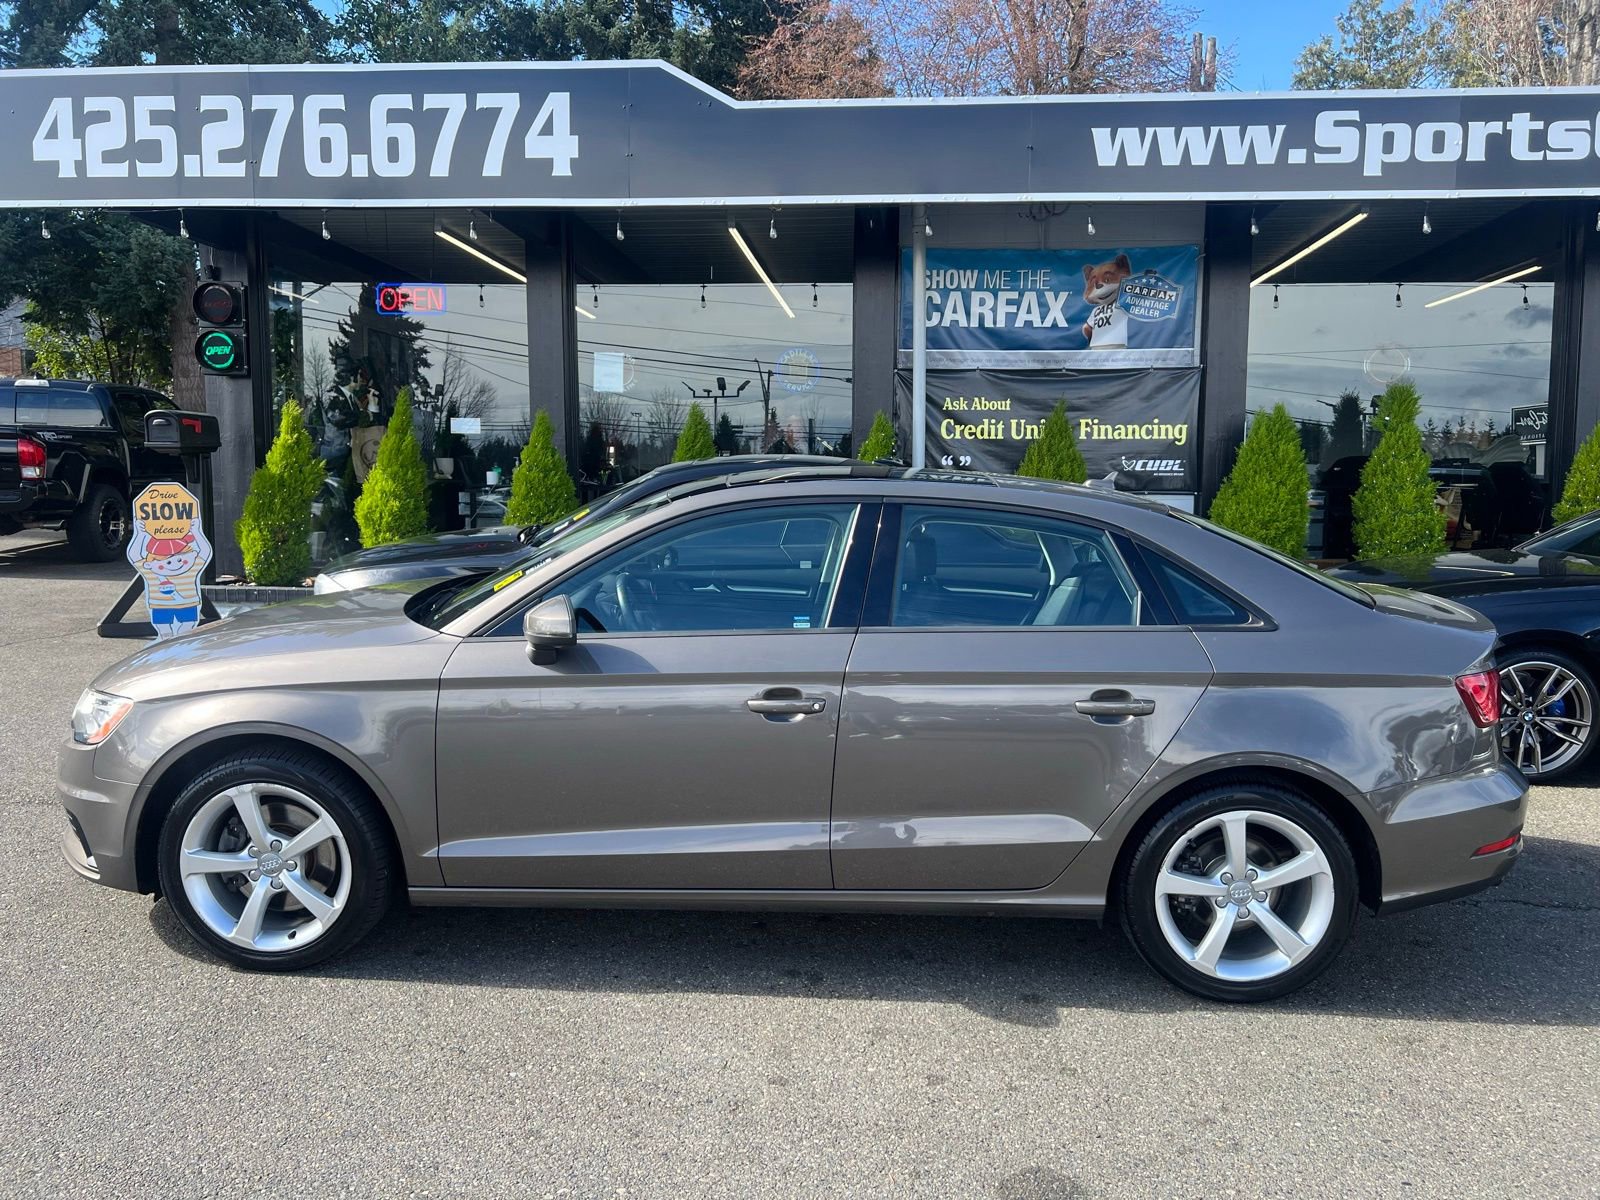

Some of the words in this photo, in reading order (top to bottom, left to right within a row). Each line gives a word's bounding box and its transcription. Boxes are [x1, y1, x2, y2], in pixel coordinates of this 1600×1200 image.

[32, 92, 579, 179] 425.276.6774
[1091, 110, 1600, 177] www.Sports
[983, 269, 1011, 289] ME
[1016, 269, 1051, 290] THE
[380, 287, 443, 311] OPEN
[1125, 285, 1176, 301] CARFAX
[926, 290, 1070, 328] CARFAX
[1094, 303, 1115, 318] CAR
[1125, 296, 1170, 311] ADVANTAGE
[1129, 305, 1160, 318] DEALER
[1093, 314, 1113, 328] FOX
[205, 345, 232, 356] OPEN
[942, 396, 969, 411] Ask
[971, 396, 1011, 411] About
[940, 418, 1005, 440] Credit
[1010, 418, 1047, 440] Uni
[1078, 417, 1188, 446] Financing
[148, 489, 179, 500] Drive
[139, 502, 194, 521] SLOW
[153, 524, 185, 536] please
